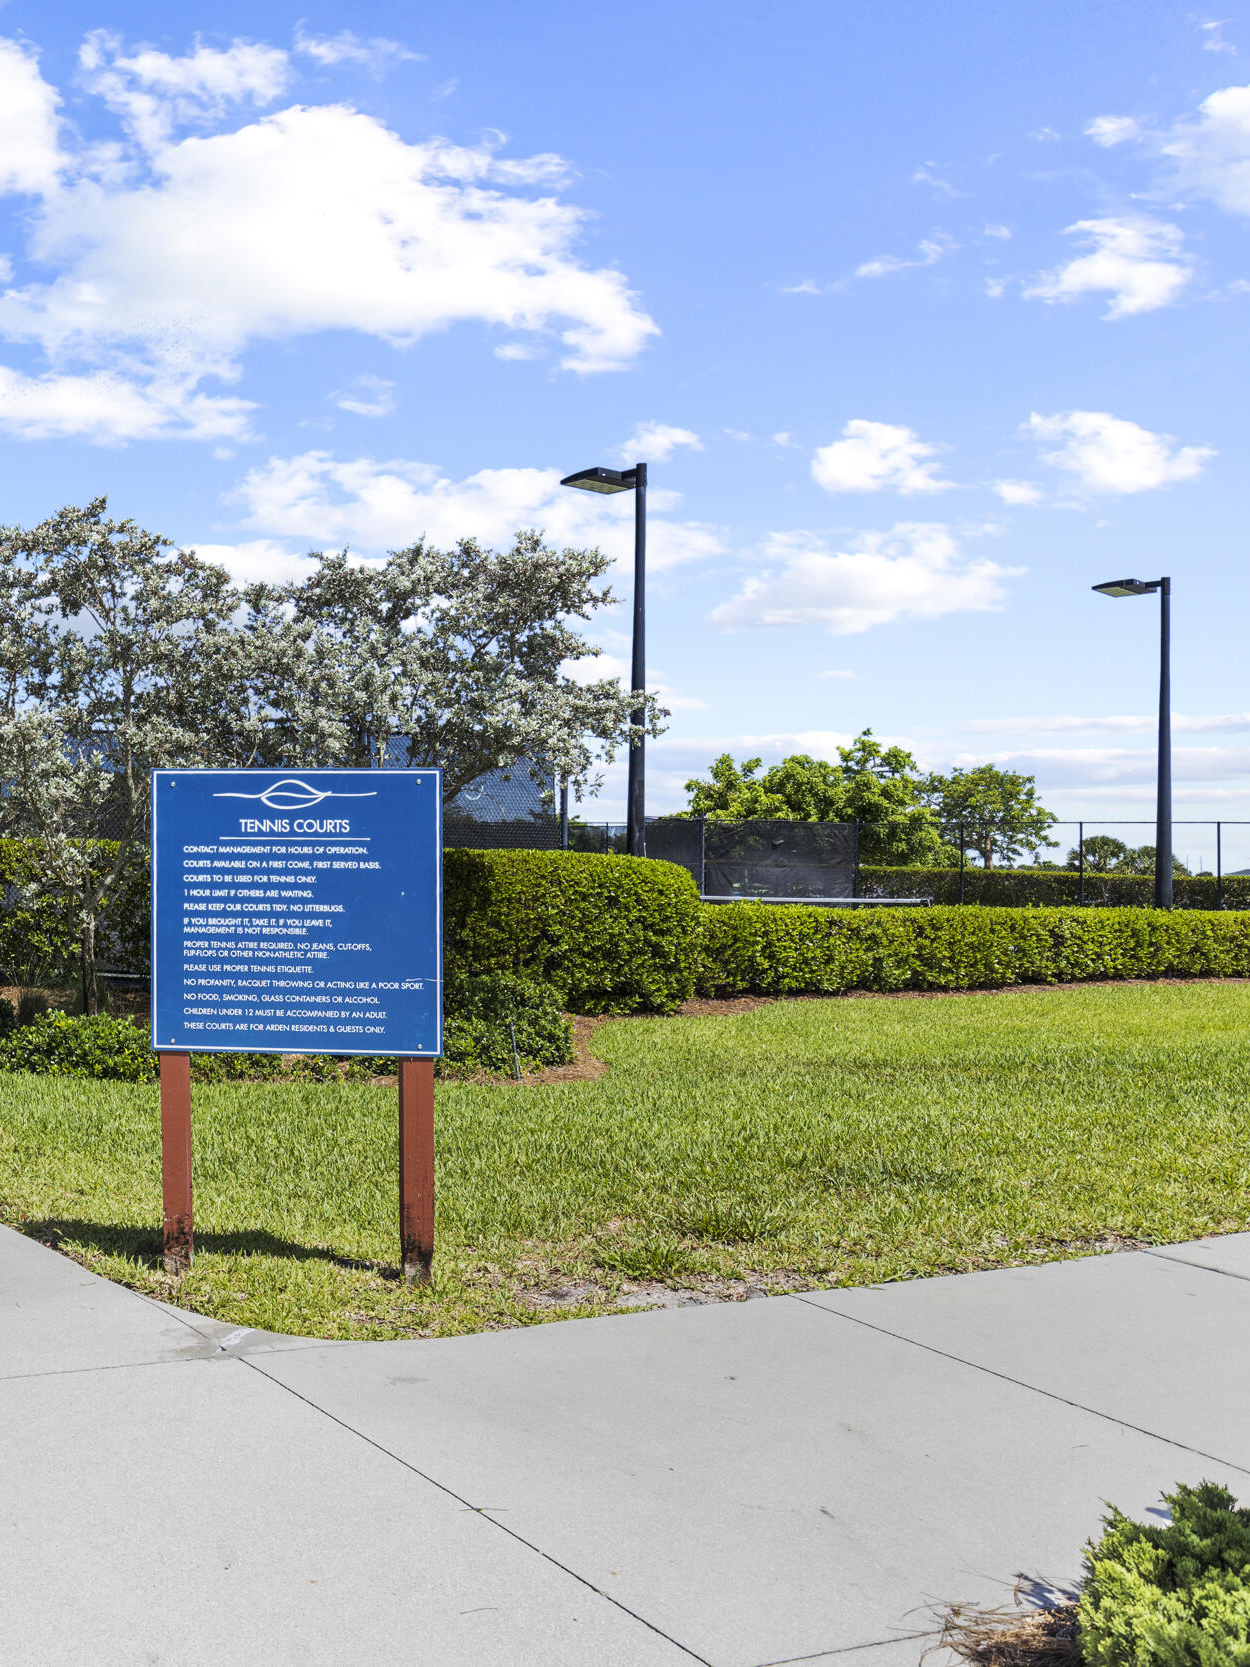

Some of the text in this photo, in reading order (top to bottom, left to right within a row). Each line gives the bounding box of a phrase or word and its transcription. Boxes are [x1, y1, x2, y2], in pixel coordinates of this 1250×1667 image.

[239, 819, 350, 834] TENNIS COURTS
[183, 845, 368, 855] CONTACT MANAGEMENT FOR HOURS OF OPERATION.
[183, 860, 383, 871] COURTS AVAILABLE ON A FIRST COME, FIRST SERVED BASIS.
[183, 874, 318, 884] COURTS TO BE USED FOR TENNIS ONLY.
[184, 889, 313, 898] 1 HOUR LIMIT IF OTHERS ARE WAITING.
[184, 903, 345, 913] PLEASE KEEP OUR COURTS TIDY. NO LITTERBUGS.
[184, 917, 189, 926] IF
[191, 917, 207, 926] YOU
[208, 917, 242, 926] BROUGHT
[252, 918, 268, 926] TAKE
[279, 918, 284, 927] IF
[286, 918, 302, 927] YOU
[304, 918, 324, 927] LEAVE
[184, 926, 307, 935] MANAGEMENT IS NOT RESPONSIBLE.
[183, 941, 209, 949] PROPER
[210, 941, 236, 949] TENNIS
[236, 941, 259, 949] ATTIRE
[259, 941, 296, 950] REQUIRED.
[297, 942, 311, 950] NO
[311, 942, 336, 951] JEANS,
[218, 950, 229, 958] OR
[230, 950, 253, 958] OTHER
[306, 951, 331, 959] ATTIRE.
[183, 964, 315, 973] PLEASE USE PROPER TENNIS ETIQUETTE.
[198, 979, 236, 988] PROFANITY,
[238, 979, 271, 987] RACQUET
[272, 980, 313, 988] THROWING
[314, 980, 325, 988] OR
[356, 981, 369, 989] LIKE
[371, 981, 377, 989] A
[378, 981, 400, 989] POOR
[183, 993, 382, 1003] NO FOOD, SMOKING, GLASS CONTAINERS OR ALCOHOL.
[183, 1007, 387, 1018] CHILDREN UNDER 12 MUST BE ACCOMPANIED BY AN ADULT.
[184, 1022, 387, 1033] THESE COURTS ARE FOR ARDEN RESIDENTS & GUESTS ONLY.
